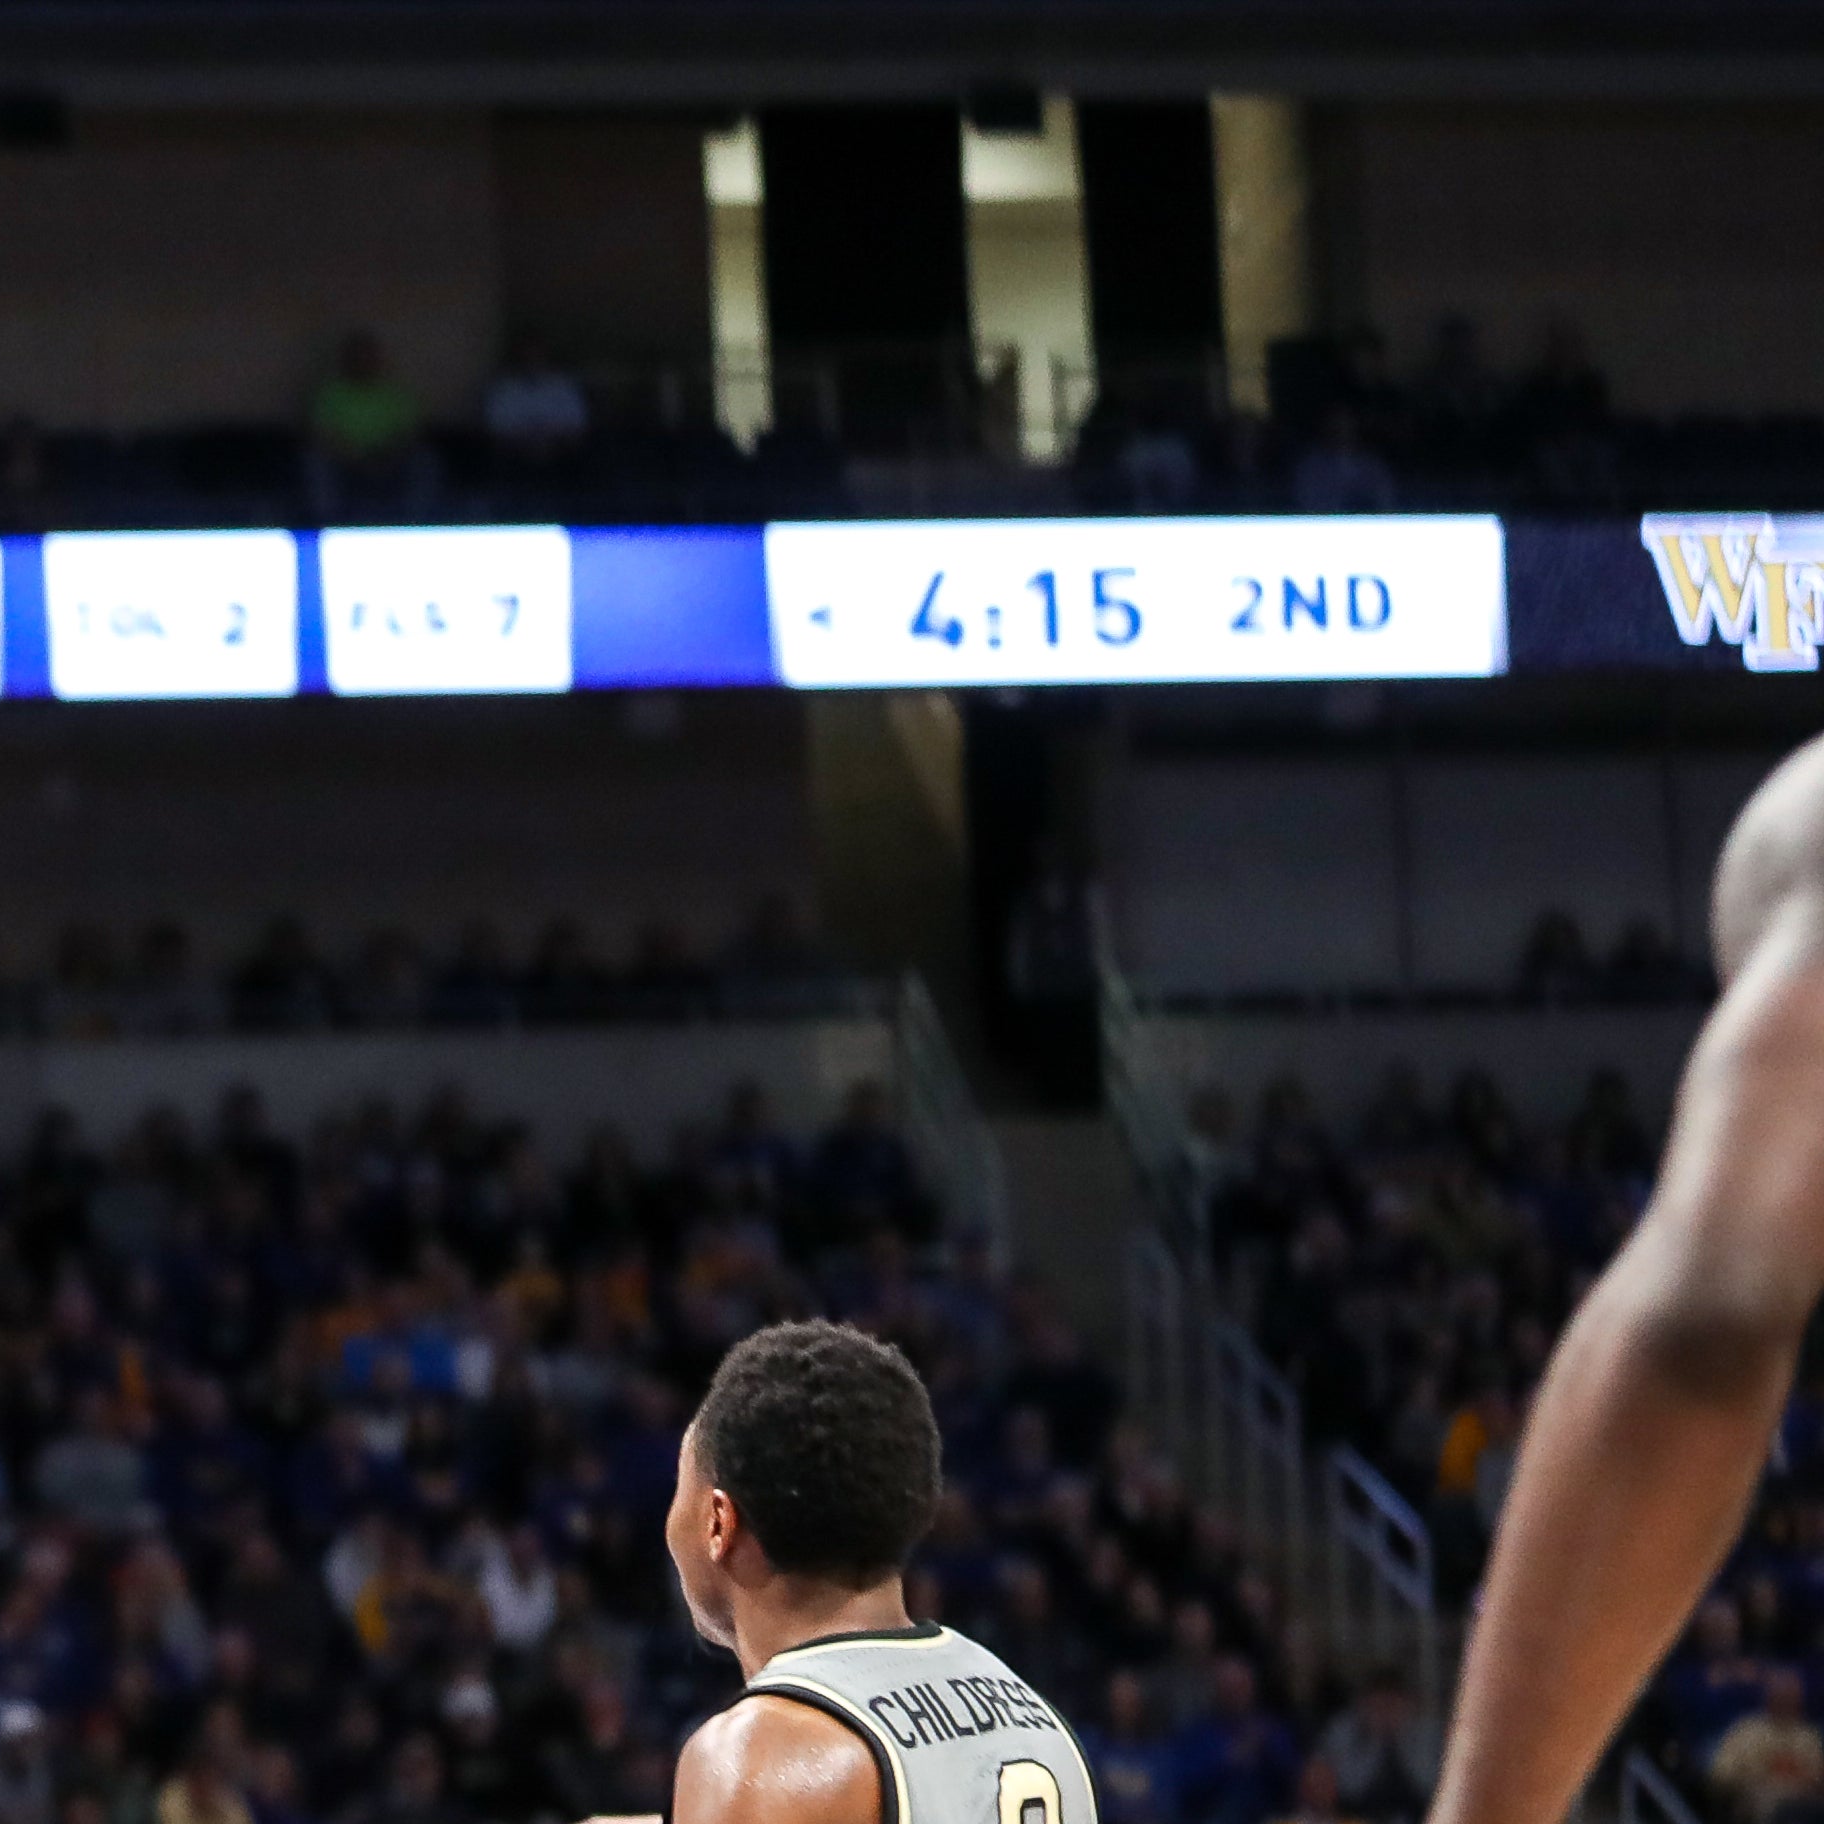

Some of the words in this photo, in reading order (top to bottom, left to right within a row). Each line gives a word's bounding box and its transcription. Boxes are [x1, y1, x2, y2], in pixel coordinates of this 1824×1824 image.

[490, 594, 521, 638] 7
[909, 565, 1144, 650] 4:15
[1229, 574, 1392, 635] 2ND
[869, 1674, 1058, 1750] CHILDRESS
